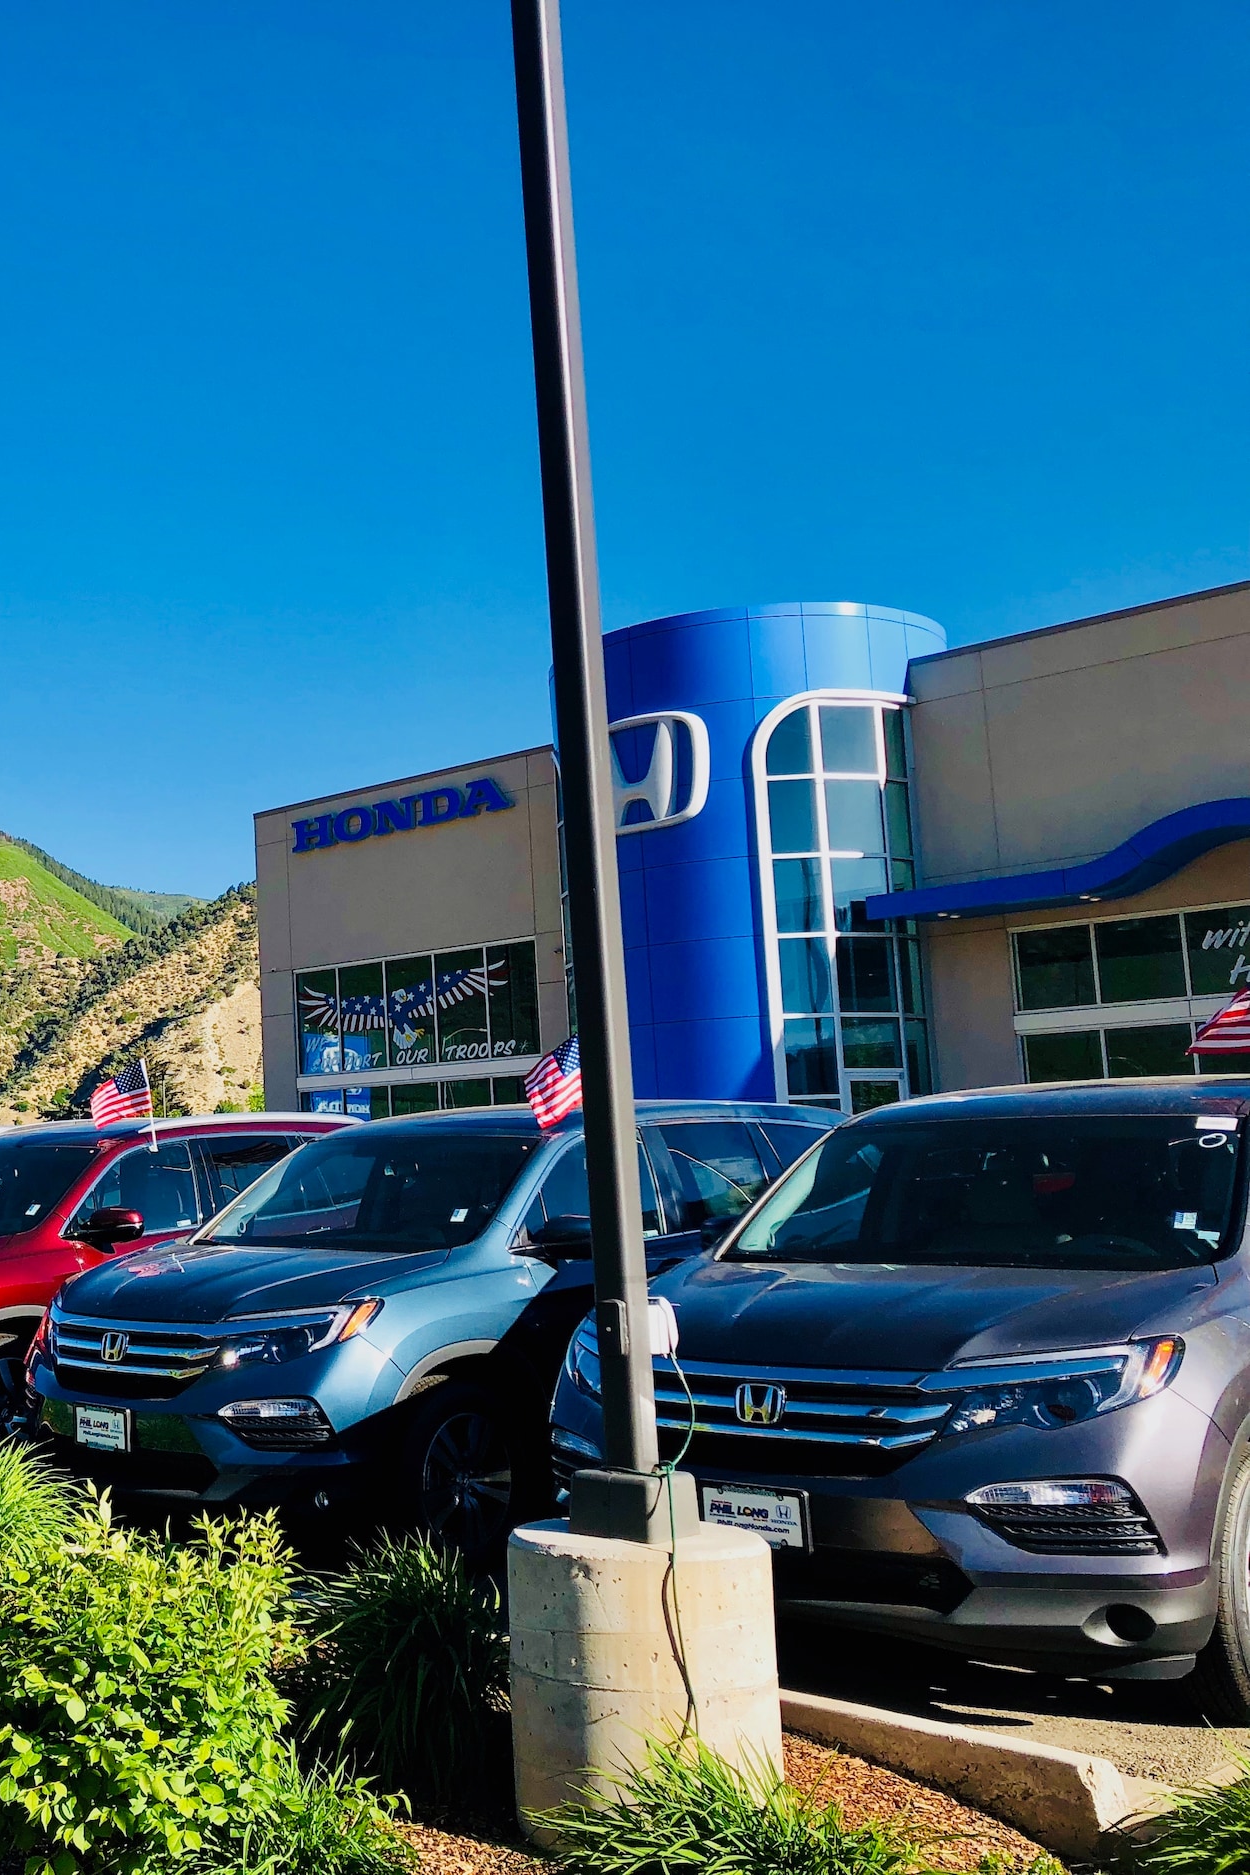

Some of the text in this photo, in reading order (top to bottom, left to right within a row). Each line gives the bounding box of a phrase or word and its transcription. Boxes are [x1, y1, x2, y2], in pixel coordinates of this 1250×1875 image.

[291, 778, 516, 853] HONDA
[395, 1047, 429, 1065] OUR
[444, 1039, 516, 1061] TROOPS
[710, 1502, 734, 1515] PHIL
[737, 1506, 769, 1519] LONG
[770, 1518, 798, 1526] HONDA
